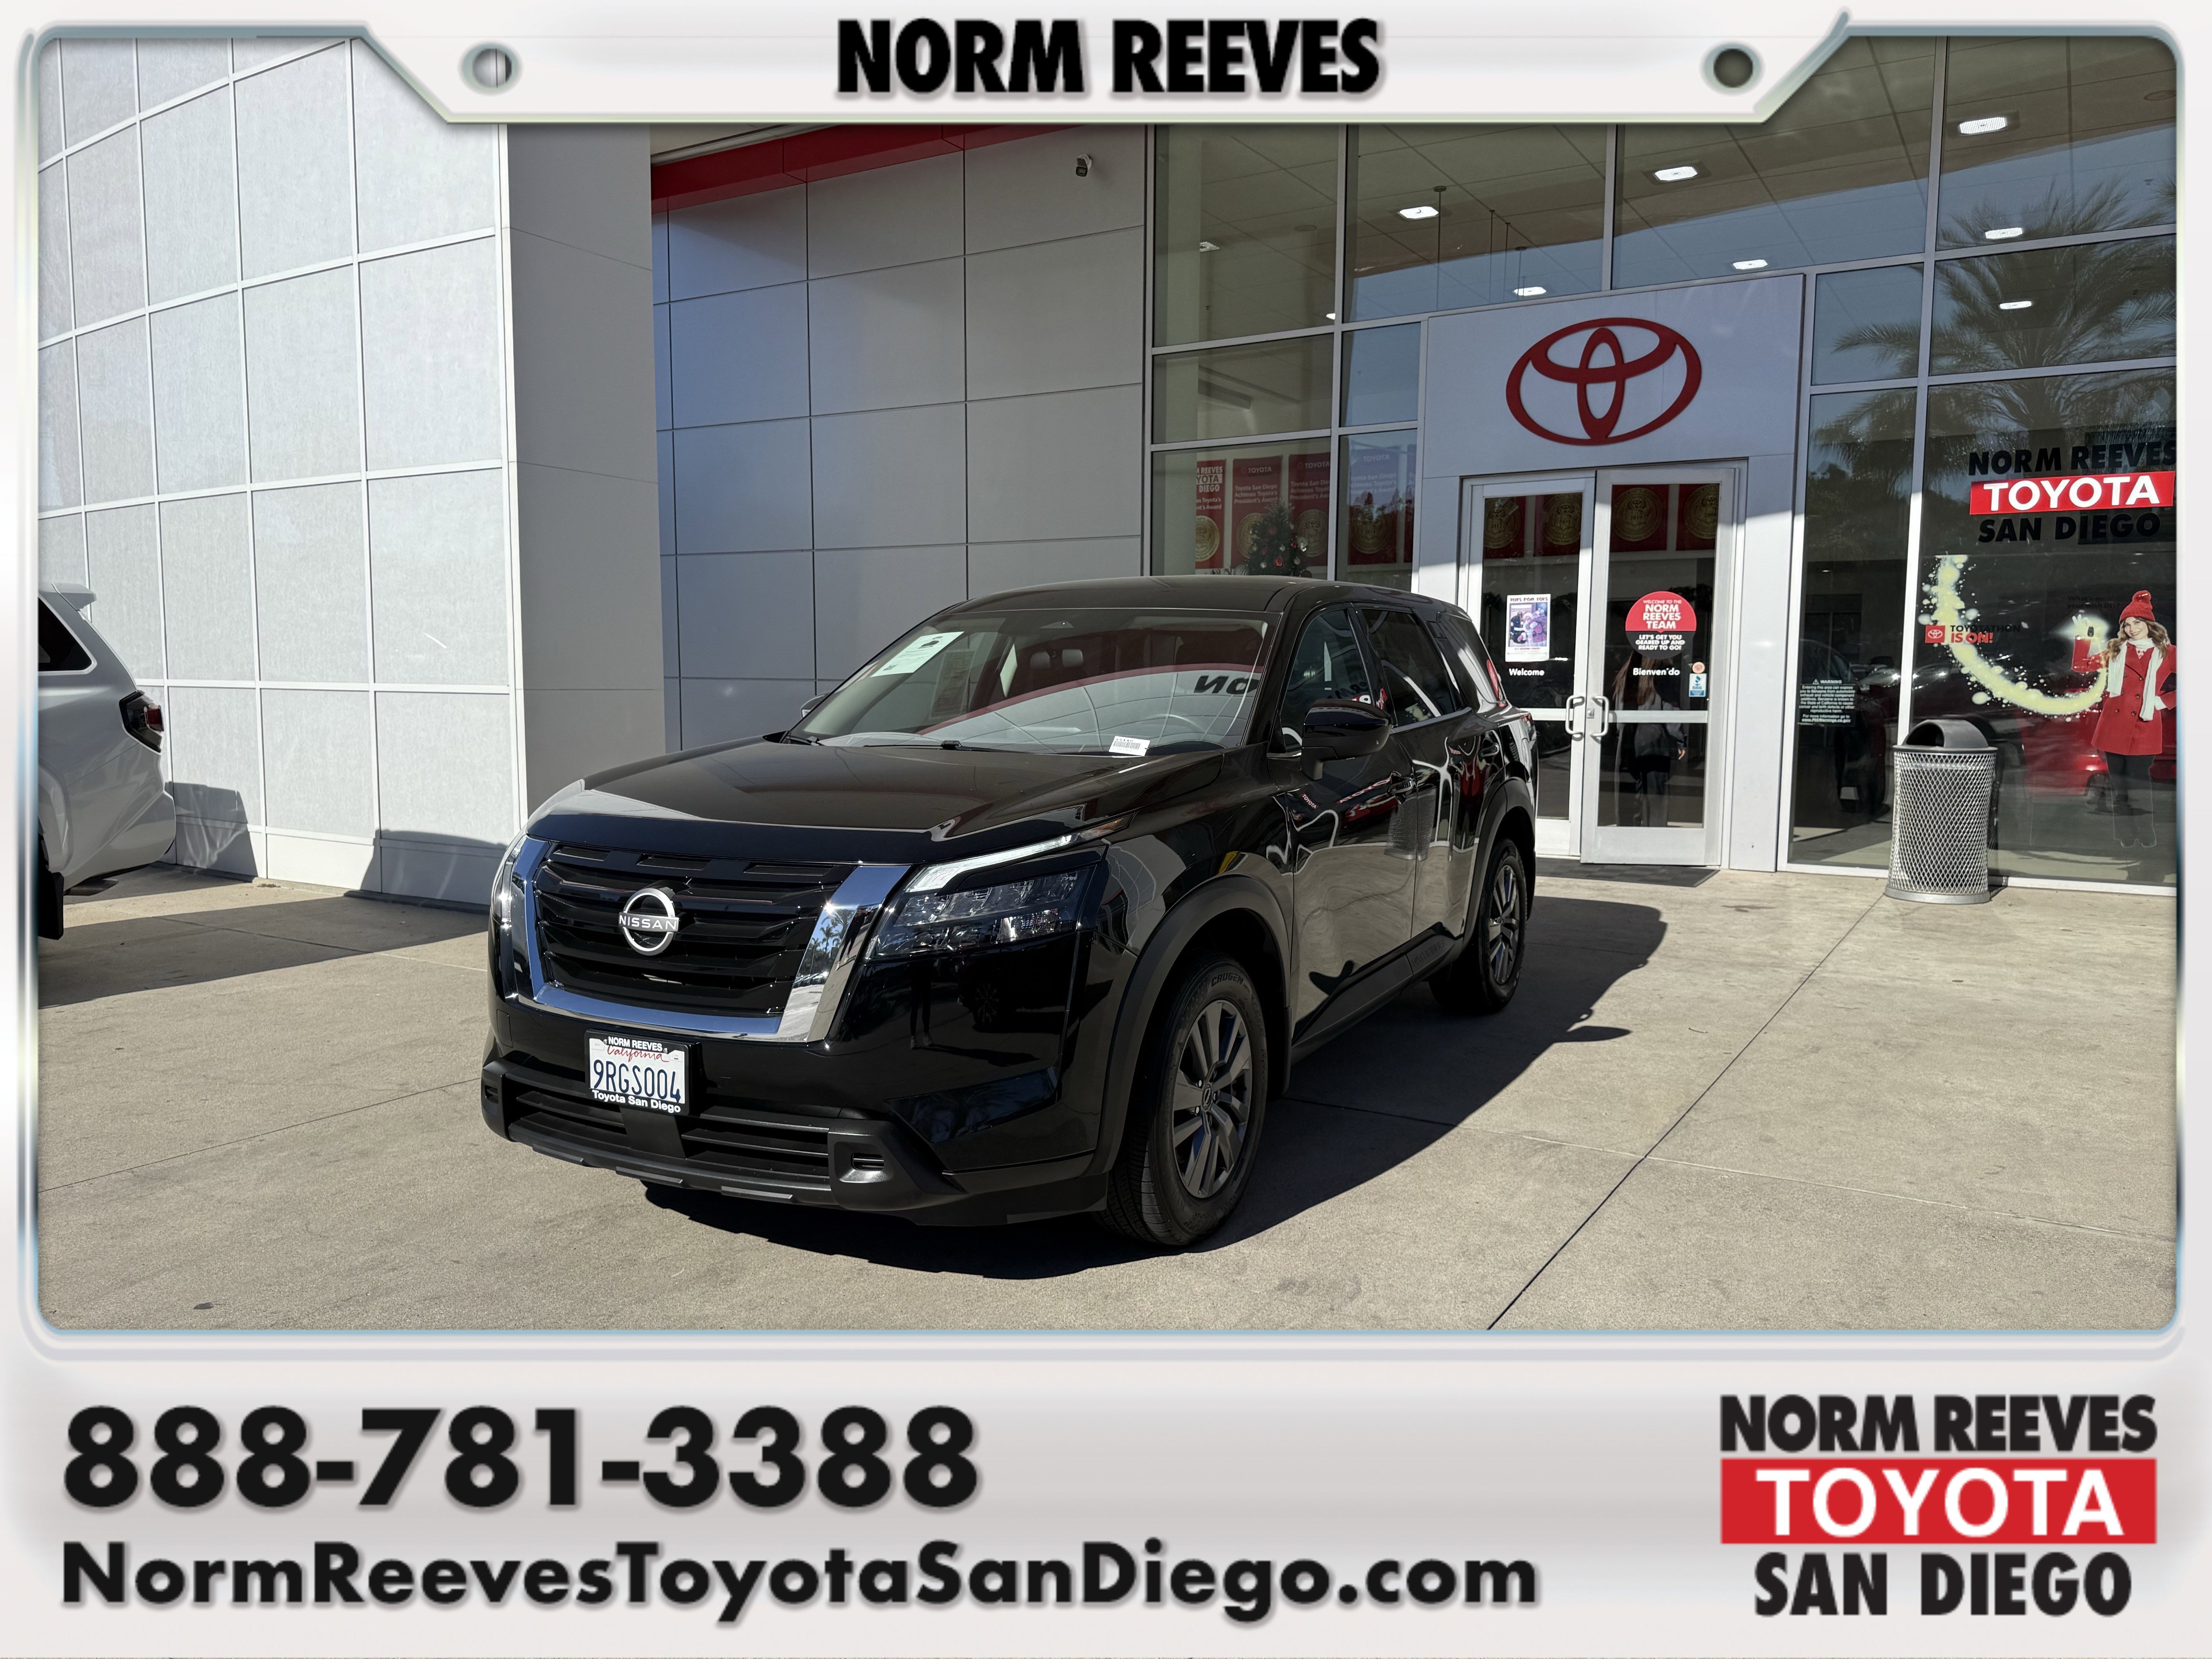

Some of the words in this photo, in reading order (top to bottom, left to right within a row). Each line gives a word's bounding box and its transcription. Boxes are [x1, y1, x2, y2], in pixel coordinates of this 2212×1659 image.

[1968, 447, 2062, 476] NORM
[2071, 440, 2176, 470] REEVES
[1197, 475, 1219, 483] YOTA
[1983, 475, 2160, 512] TOYOTA
[1978, 517, 2042, 543] SAN
[2055, 512, 2161, 540] DIEGO
[1645, 604, 1679, 612] NORM
[1643, 612, 1681, 621] REEVES
[1646, 621, 1676, 629] TEAM
[1951, 633, 1963, 643] IS
[1966, 632, 1993, 643] ON!
[620, 915, 676, 930] NISSAN
[608, 1036, 630, 1048] NORM
[632, 1039, 663, 1052] REEVES
[607, 1046, 669, 1062] California
[593, 1059, 681, 1103] 9RGS004
[592, 1090, 625, 1103] Toyota
[628, 1096, 648, 1107] San
[651, 1099, 681, 1113] Diego
